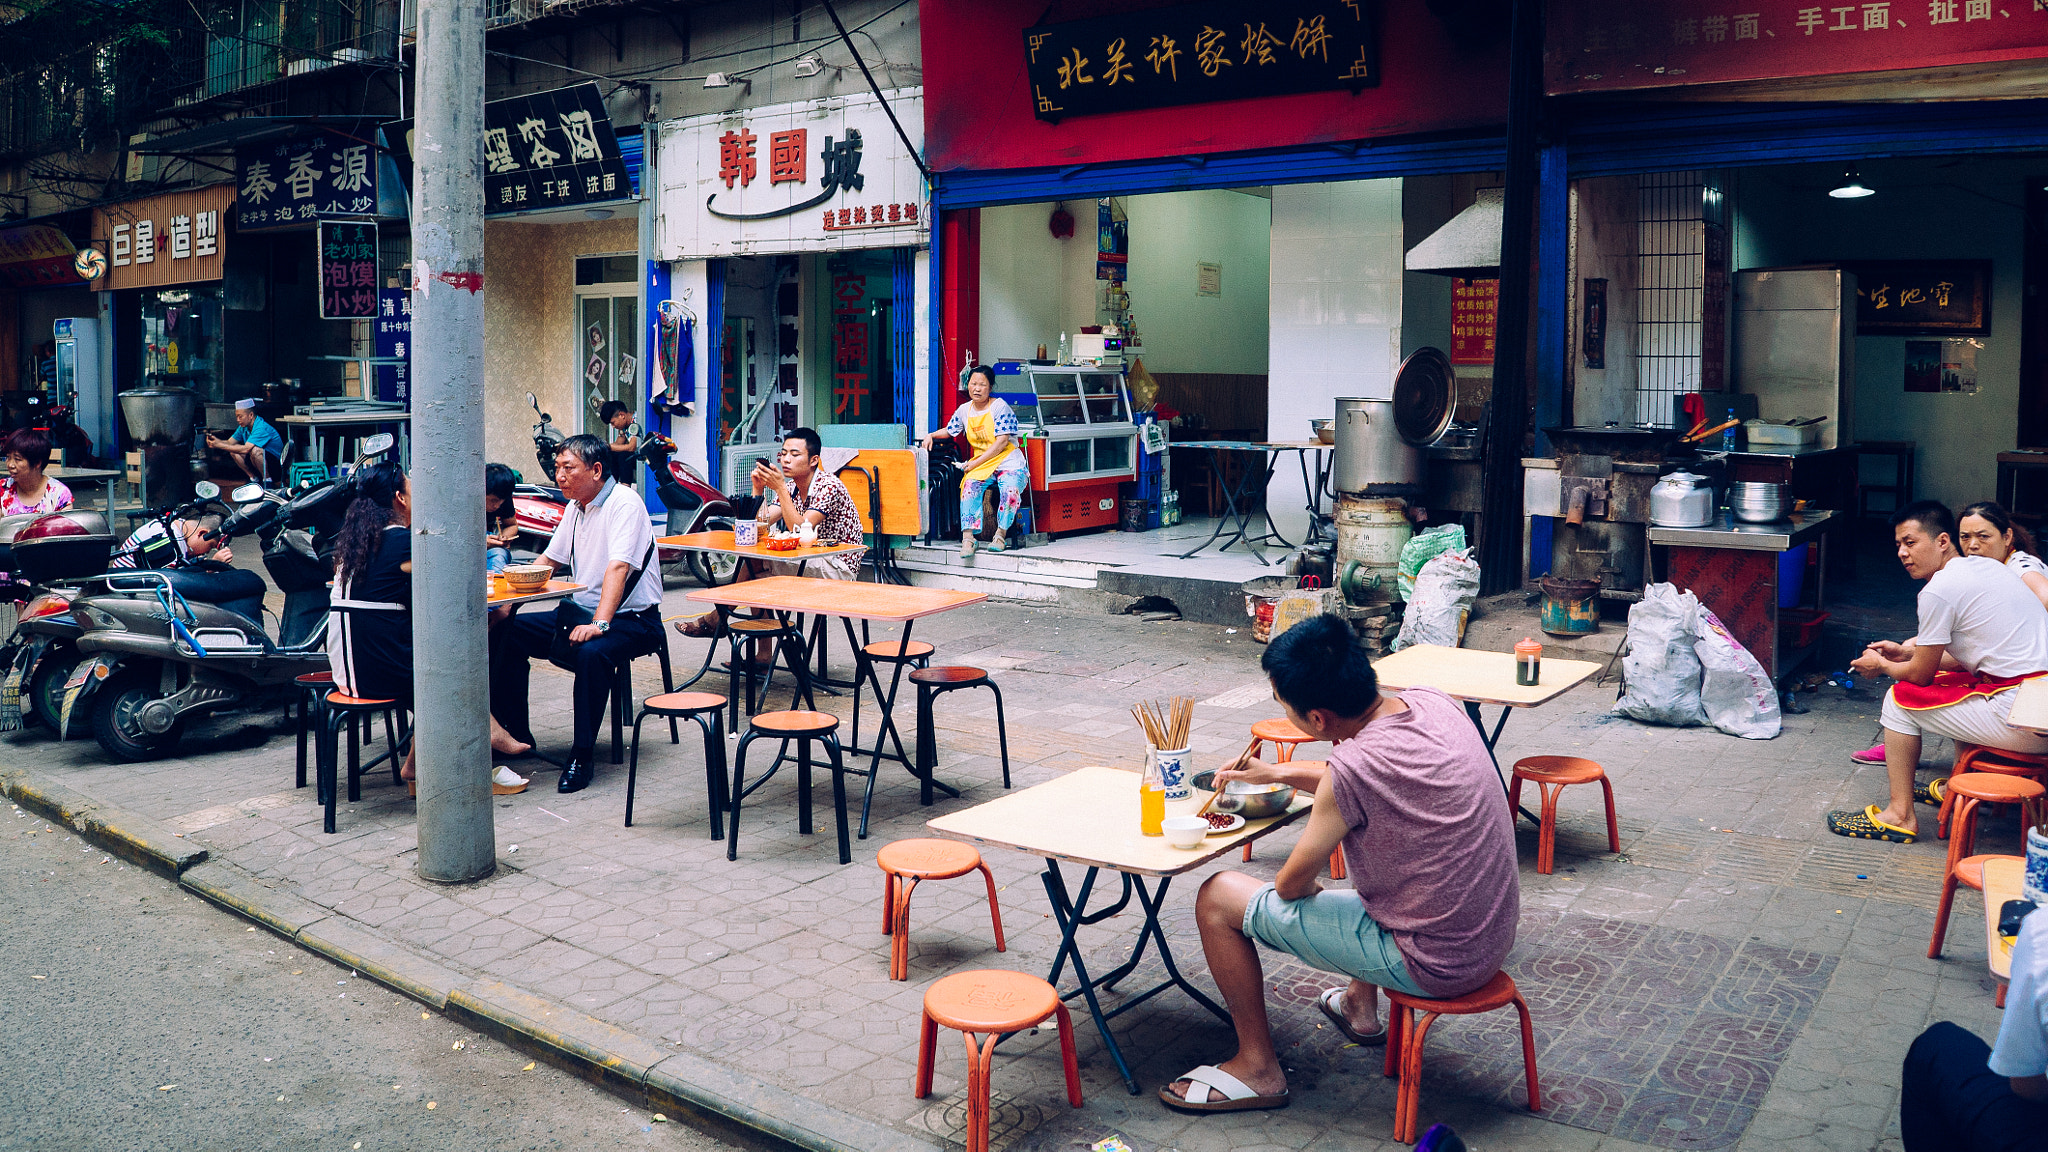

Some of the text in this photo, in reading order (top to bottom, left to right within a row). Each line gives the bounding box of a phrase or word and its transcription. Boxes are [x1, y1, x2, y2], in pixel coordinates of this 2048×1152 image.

[1057, 15, 1333, 89] 北关许家烩饼
[241, 145, 373, 204] 秦香源
[501, 173, 616, 204] 烫发 干洗 洗面
[274, 196, 374, 221] 泡馍小炒
[822, 203, 919, 228] 造型染烫基地
[113, 220, 154, 267] 巨星
[171, 210, 218, 260] 造型
[332, 225, 365, 242] 清真
[324, 242, 375, 260] 老刘家
[324, 261, 376, 288] 泡馍
[325, 289, 376, 316] 小炒
[382, 297, 412, 317] 清真
[834, 271, 869, 424] 空调开
[395, 342, 406, 403] 秦香源
